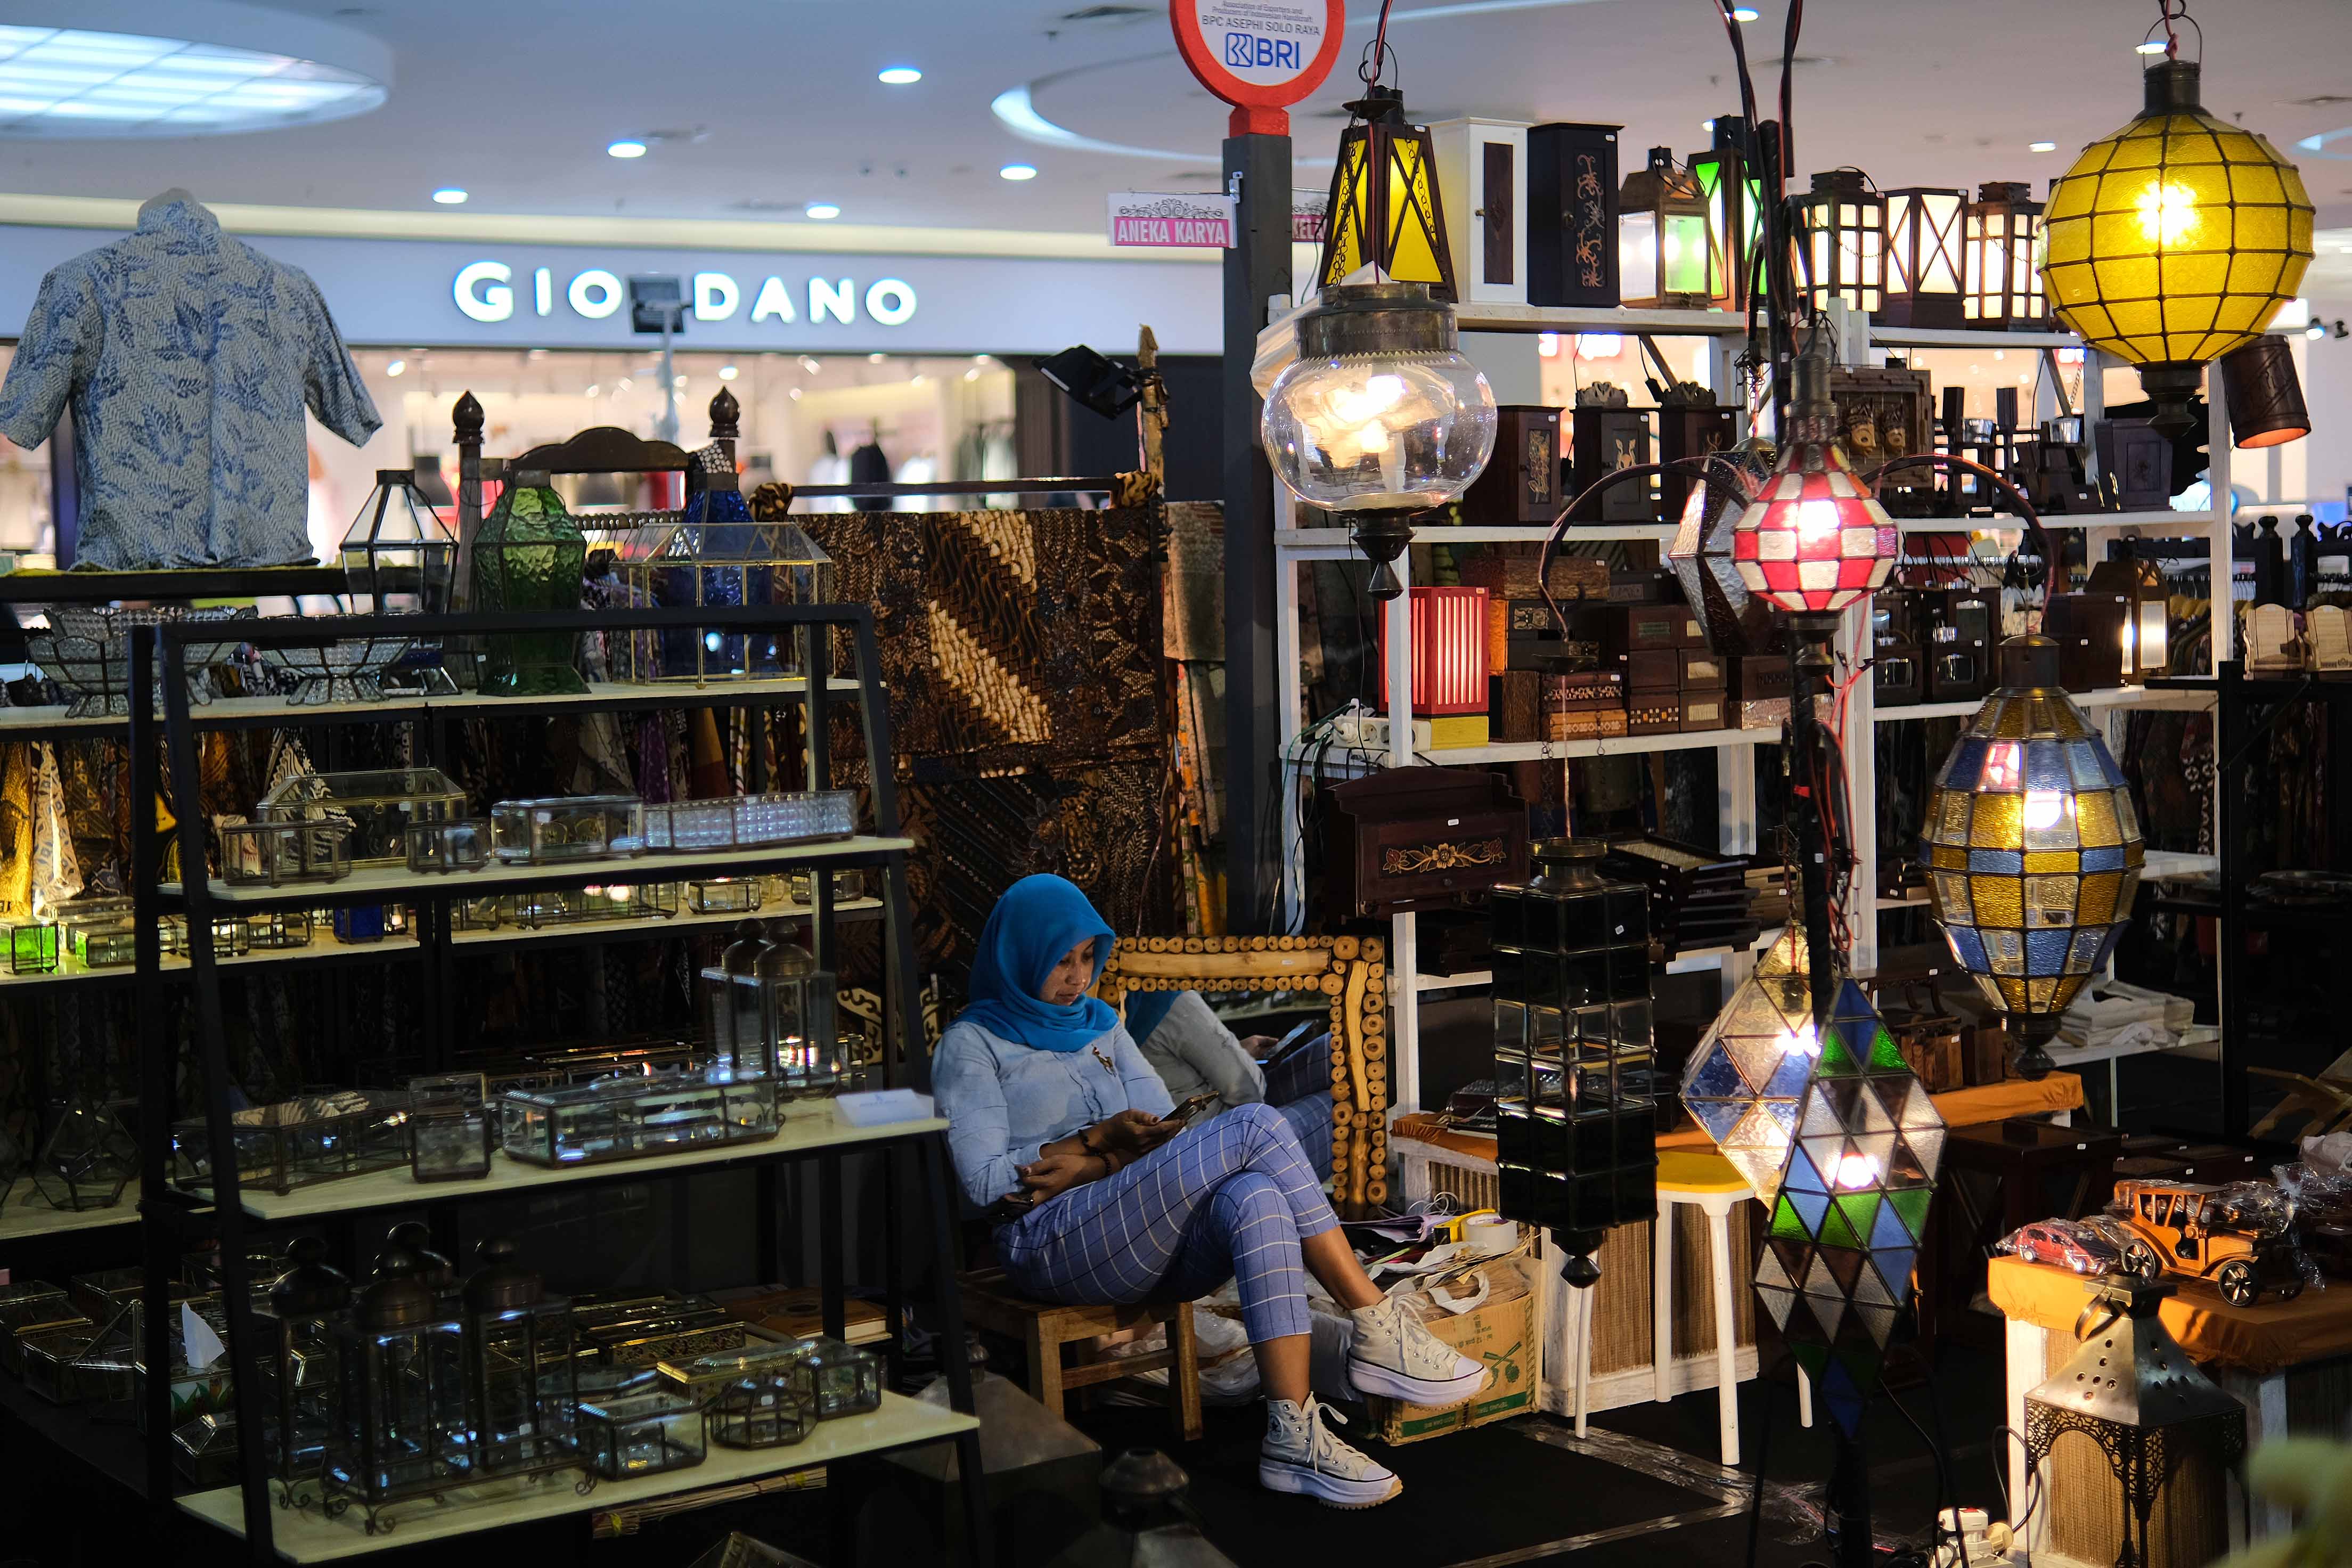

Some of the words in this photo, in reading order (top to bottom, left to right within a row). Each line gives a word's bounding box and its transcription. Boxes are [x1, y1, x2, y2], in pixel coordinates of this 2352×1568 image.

[1202, 15, 1223, 26] BPC
[1226, 18, 1263, 30] ASEPHI
[1265, 21, 1292, 32] SOLO
[1295, 24, 1321, 36] RAYA
[1257, 37, 1300, 69] BRI
[1117, 220, 1170, 242] ANEKA
[1174, 221, 1227, 244] KARYA
[453, 261, 917, 326] GIODANO
